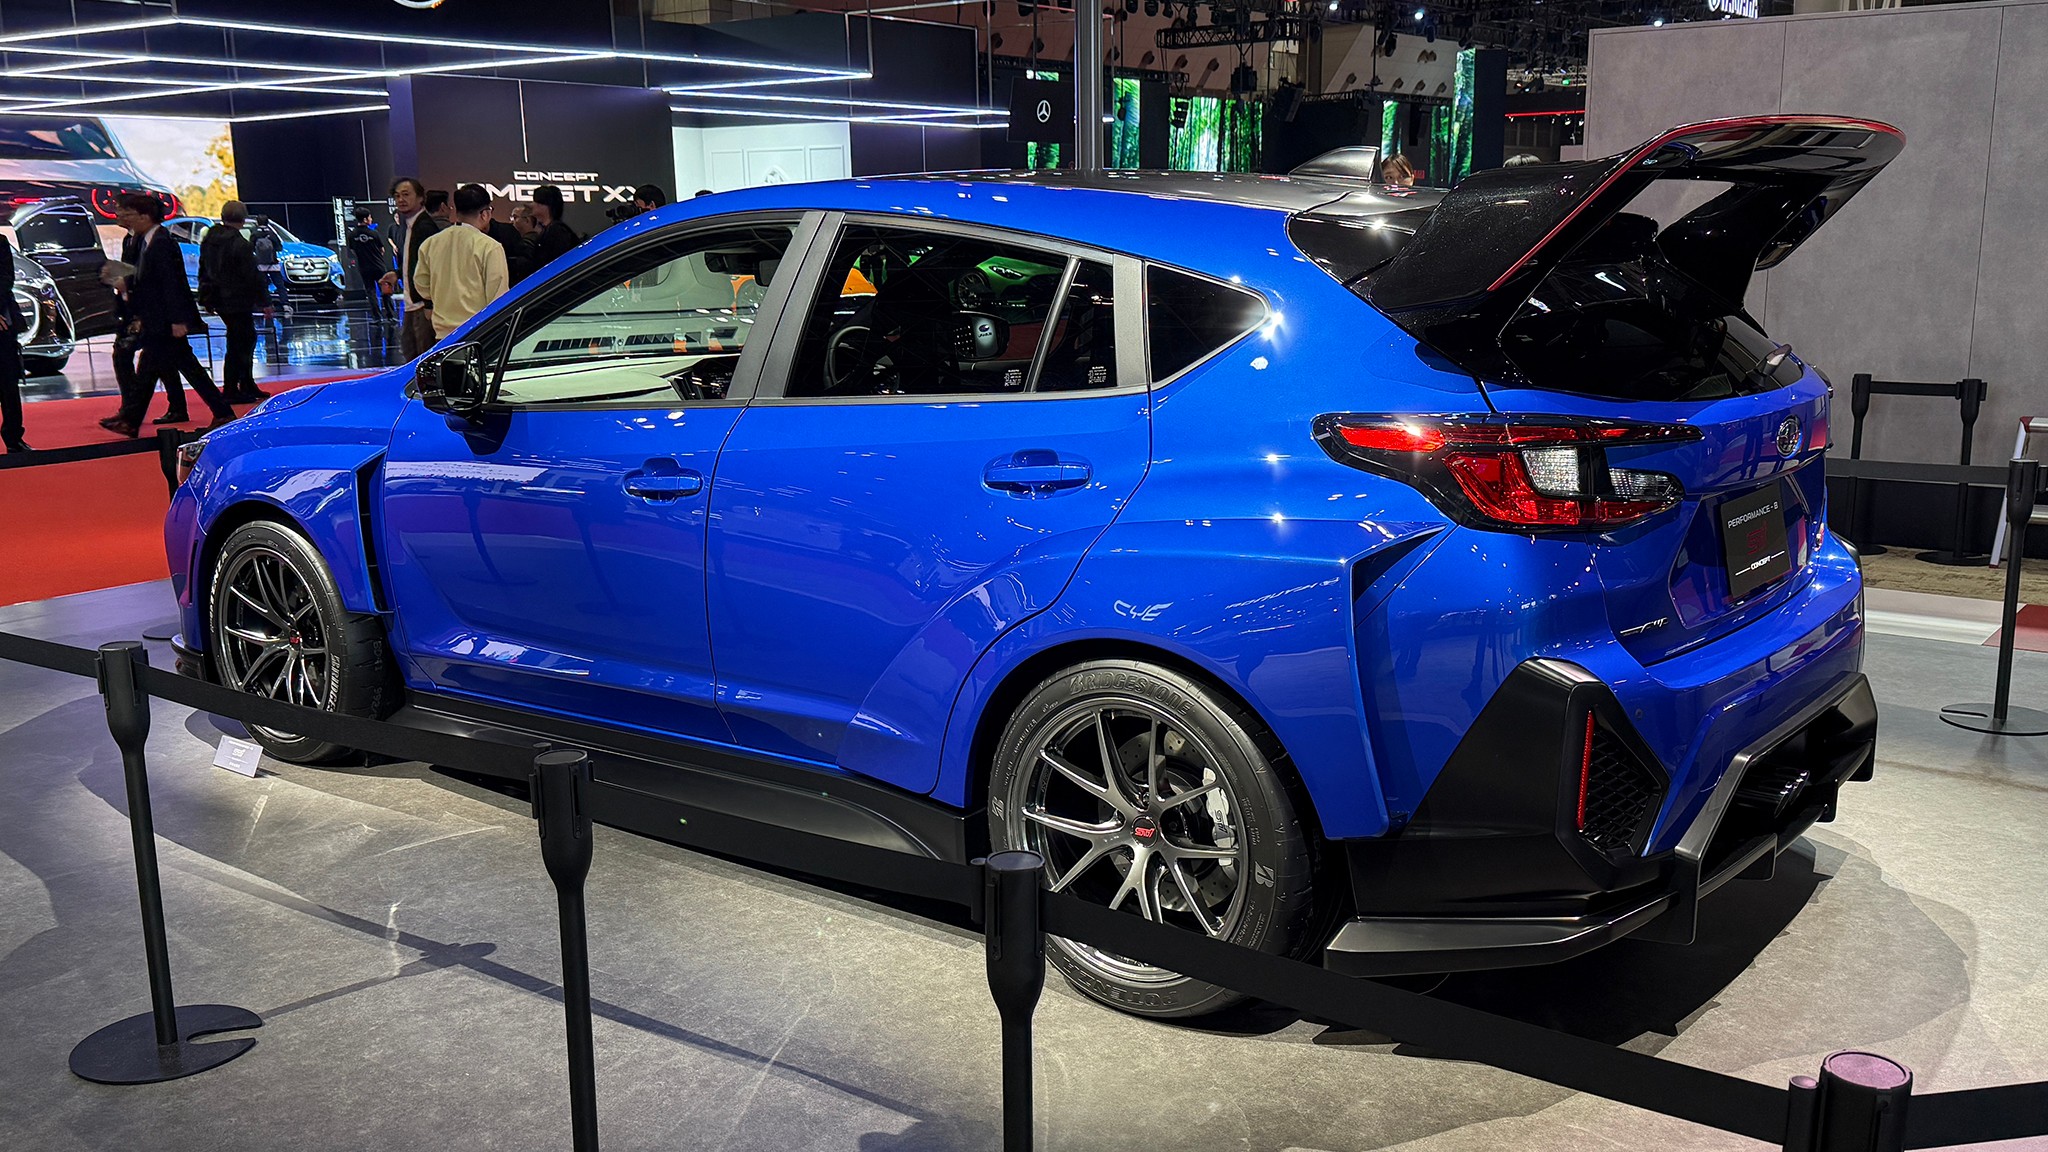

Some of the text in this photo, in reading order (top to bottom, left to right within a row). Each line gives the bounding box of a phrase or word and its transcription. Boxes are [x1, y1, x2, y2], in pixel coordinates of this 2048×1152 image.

[513, 170, 599, 182] CONCEPT
[457, 183, 541, 202] MG
[1727, 504, 1771, 529] PERFORMANCE
[1750, 555, 1771, 570] CONCEPT
[1069, 671, 1195, 717] BRIDGESTONE
[1062, 956, 1178, 1007] POTENZA
